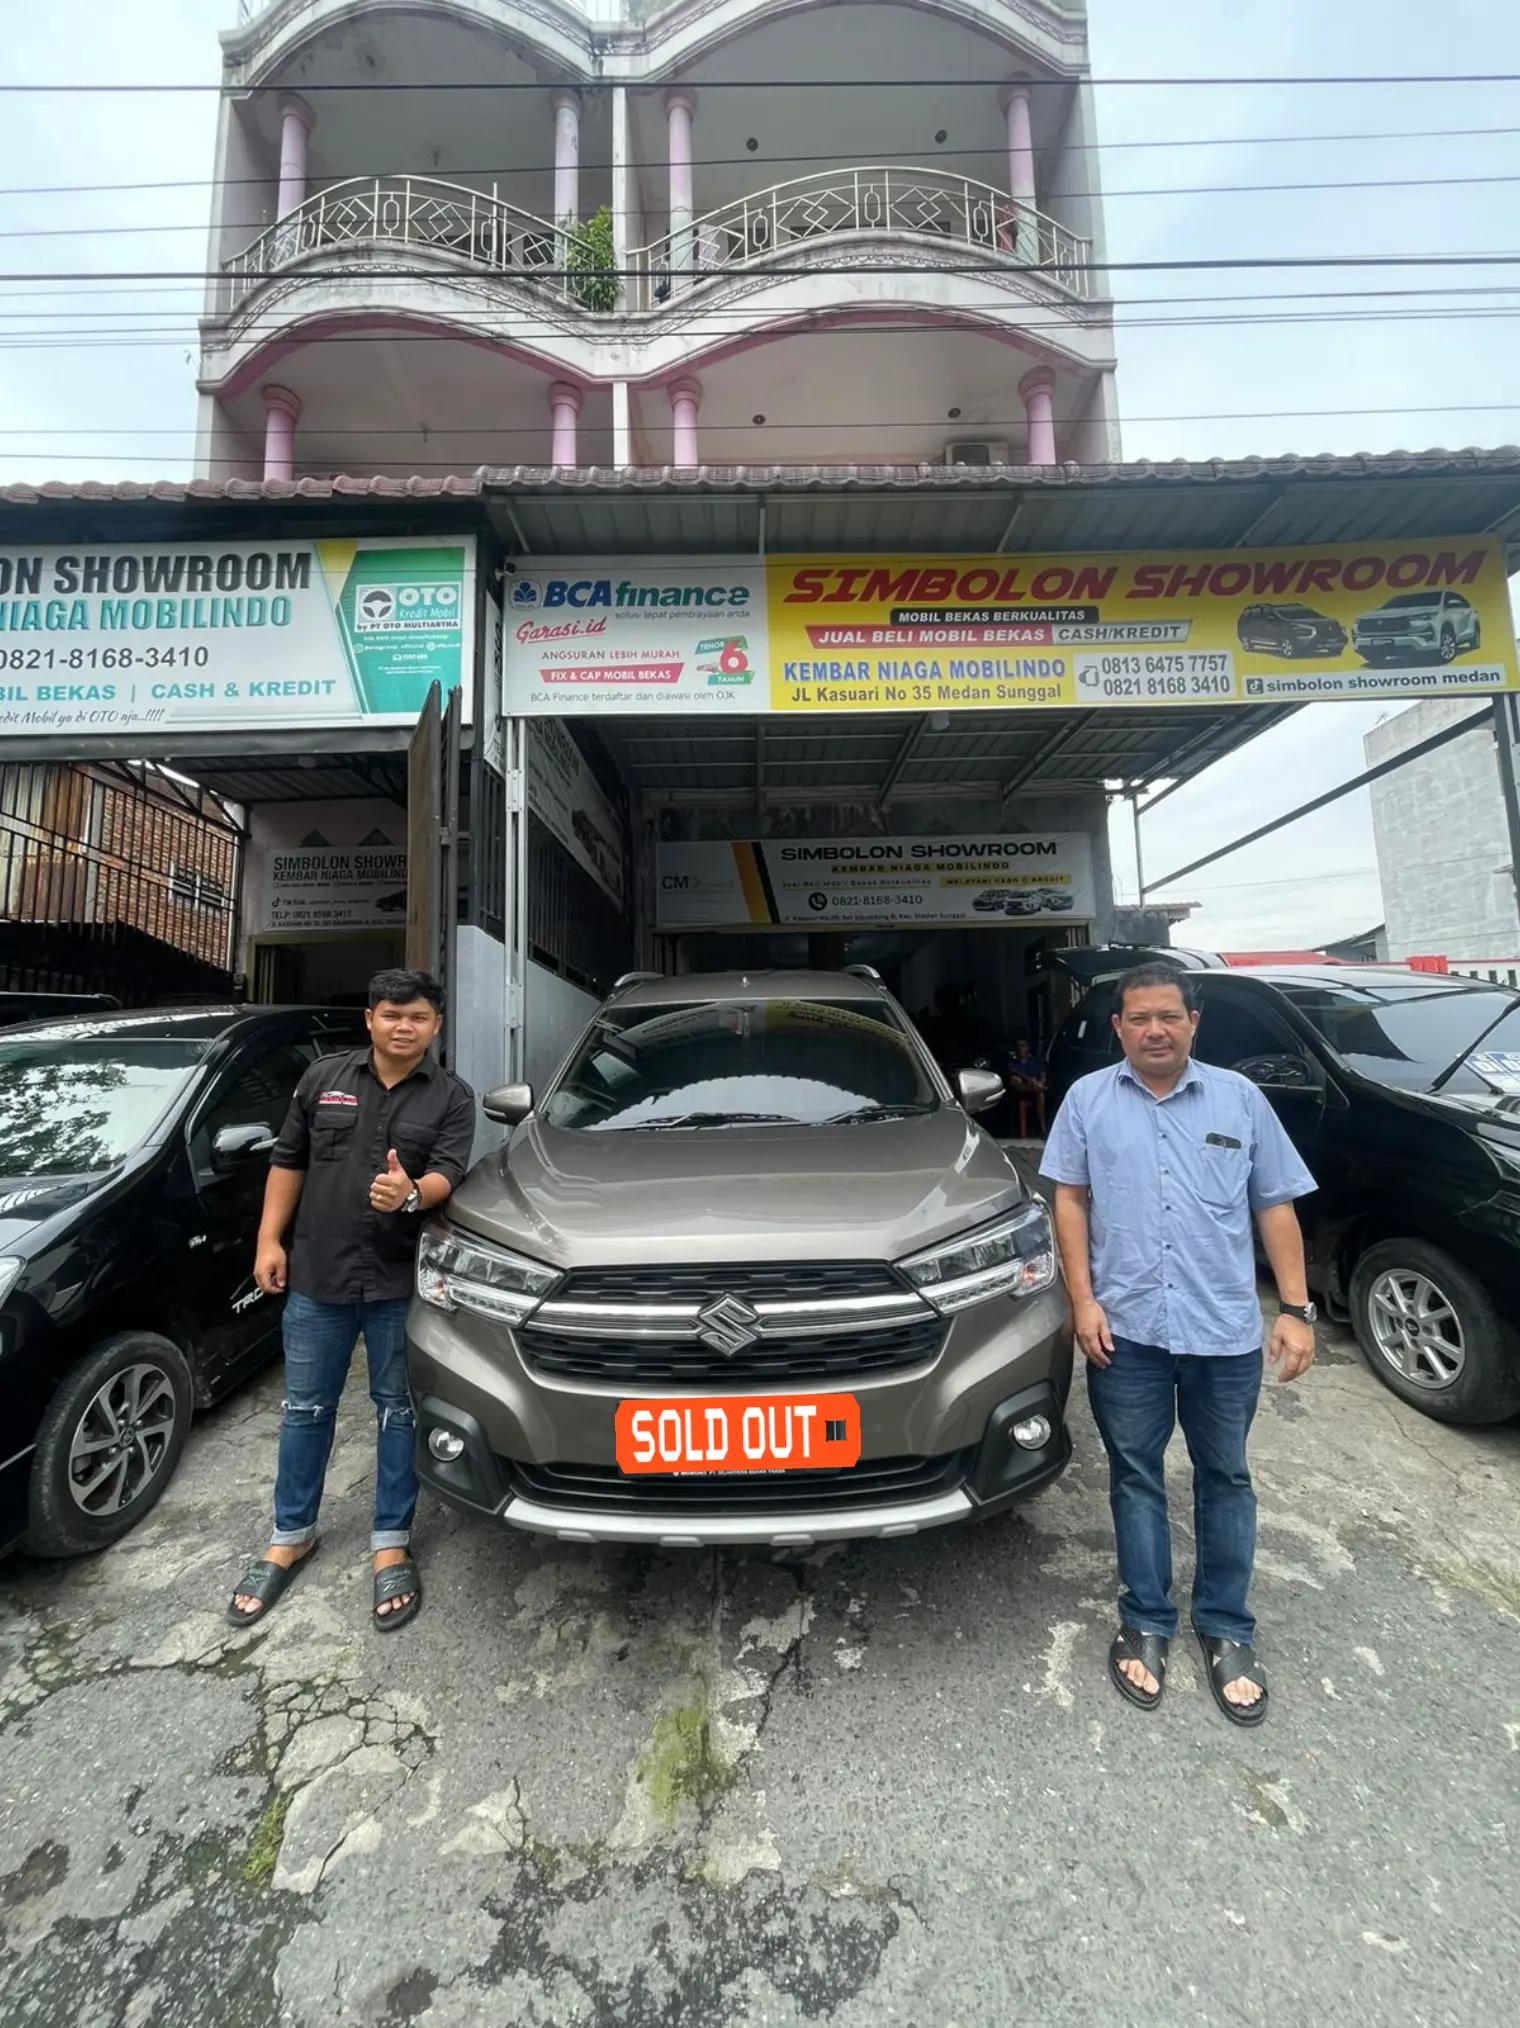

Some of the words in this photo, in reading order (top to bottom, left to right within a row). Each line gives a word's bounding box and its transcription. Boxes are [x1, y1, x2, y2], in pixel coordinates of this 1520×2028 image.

[54, 552, 311, 593] SHOWROOM
[784, 567, 1118, 602] SIMBOLON
[1125, 550, 1487, 598] SHOWROOM
[399, 587, 458, 606] OTO
[100, 596, 292, 630] MOBILINDO
[400, 608, 428, 618] Kredit
[430, 607, 456, 618] Mobil
[615, 611, 640, 619] solusi
[643, 610, 667, 620] tepat
[669, 610, 724, 620] pembiayaan
[727, 609, 750, 618] anda
[899, 611, 941, 623] MOBIL
[945, 611, 989, 622] BEKAS
[993, 609, 1085, 621] BERKUALITAS
[383, 622, 401, 630] OTO
[403, 620, 458, 629] MULTIARTHA
[515, 616, 607, 644] Garasi.id
[818, 630, 866, 644] JUAL
[872, 630, 913, 643] BELI
[919, 629, 978, 643] MOBIL
[983, 628, 1045, 642] BEKAS
[1058, 624, 1182, 641] CASH/KREDIT
[0, 646, 208, 670] 0821-8168-3410
[541, 650, 605, 660] ANGSURAN
[610, 650, 638, 659] LEBIH
[641, 650, 680, 659] MURAH
[720, 640, 748, 674] 6
[1102, 656, 1140, 674] 0813
[1146, 655, 1184, 672] 6475
[1188, 654, 1228, 672] 7757
[551, 671, 568, 681] FIX
[570, 671, 577, 681] &
[580, 671, 601, 681] CAP
[603, 670, 636, 680] MOBIL
[638, 669, 671, 680] BEKAS
[717, 675, 745, 684] TAHUN
[784, 662, 870, 682] KEMBAR
[878, 660, 942, 680] NIAGA
[949, 659, 1065, 679] MOBILINDO
[1103, 678, 1143, 696] 0821
[1148, 677, 1186, 695] 8168
[1191, 675, 1230, 693] 3410
[1267, 675, 1344, 692] simbolon
[1348, 673, 1437, 690] showroom
[1441, 669, 1501, 685] medan
[37, 683, 116, 701] BEKAS
[151, 682, 215, 699] CASH
[224, 682, 239, 697] &
[249, 680, 336, 697] KREDIT
[531, 692, 549, 702] BCA
[553, 692, 591, 702] Finance
[592, 692, 633, 701] terdaftar
[636, 692, 652, 701] dan
[656, 692, 690, 701] diawasi
[792, 688, 811, 702] JL
[817, 687, 879, 702] Kasuari
[885, 686, 906, 700] No
[912, 686, 931, 700] 35
[938, 685, 990, 700] Medan
[996, 684, 1061, 702] Sunggal
[21, 710, 58, 724] Mobil
[58, 714, 73, 728] ya
[75, 710, 87, 722] di
[91, 711, 119, 724] OTO
[780, 846, 902, 862] SIMBOLON
[911, 842, 1057, 859] SHOWROOM
[274, 856, 349, 870] SIMBOLON
[831, 864, 885, 873] KEMBAR
[891, 863, 932, 872] NIAGA
[936, 862, 1010, 871] MOBILINDO
[272, 870, 317, 881] KEMBAR
[320, 870, 353, 880] NIAGA
